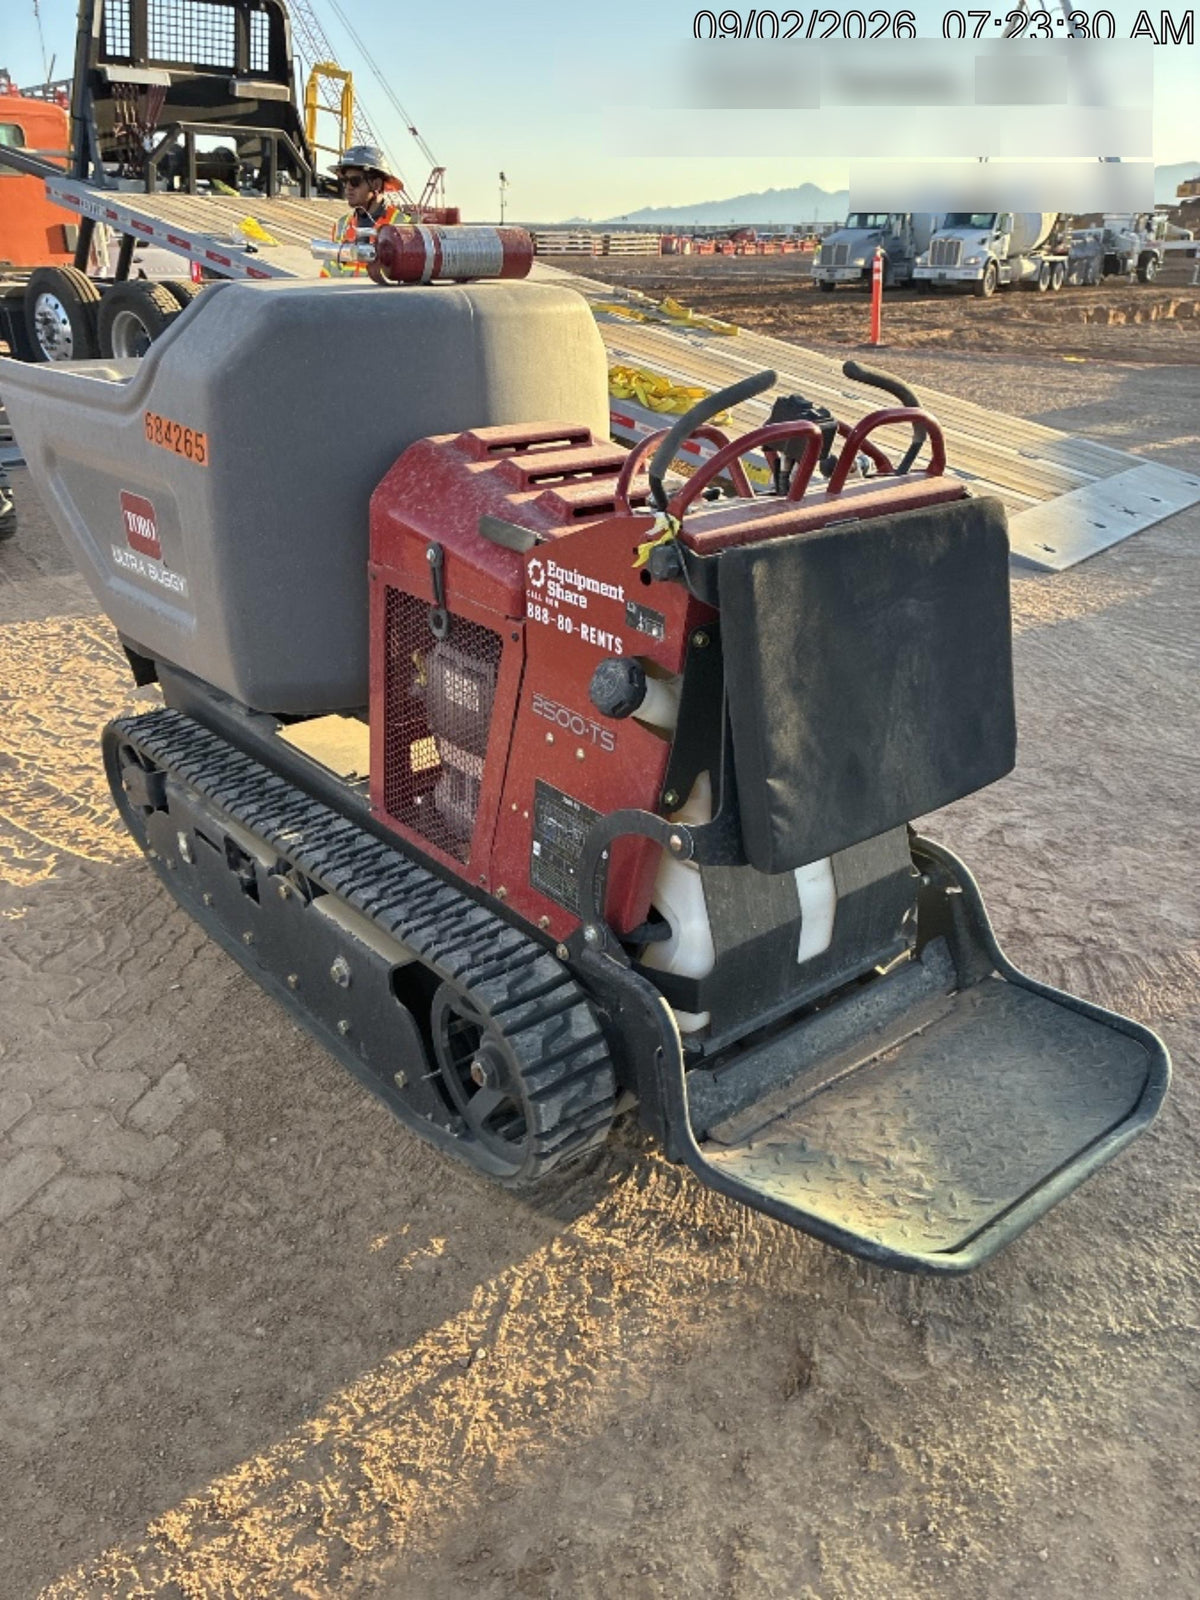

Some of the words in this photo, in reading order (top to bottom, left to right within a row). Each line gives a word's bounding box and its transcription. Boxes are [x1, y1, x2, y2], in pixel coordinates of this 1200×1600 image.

[145, 412, 206, 463] 684265
[124, 509, 156, 541] TORO
[113, 546, 146, 575] ULTRA
[147, 563, 186, 592] BUGGY
[546, 560, 625, 602] Equipment
[547, 579, 587, 609] Share
[526, 602, 623, 655] 888-80-RENTS
